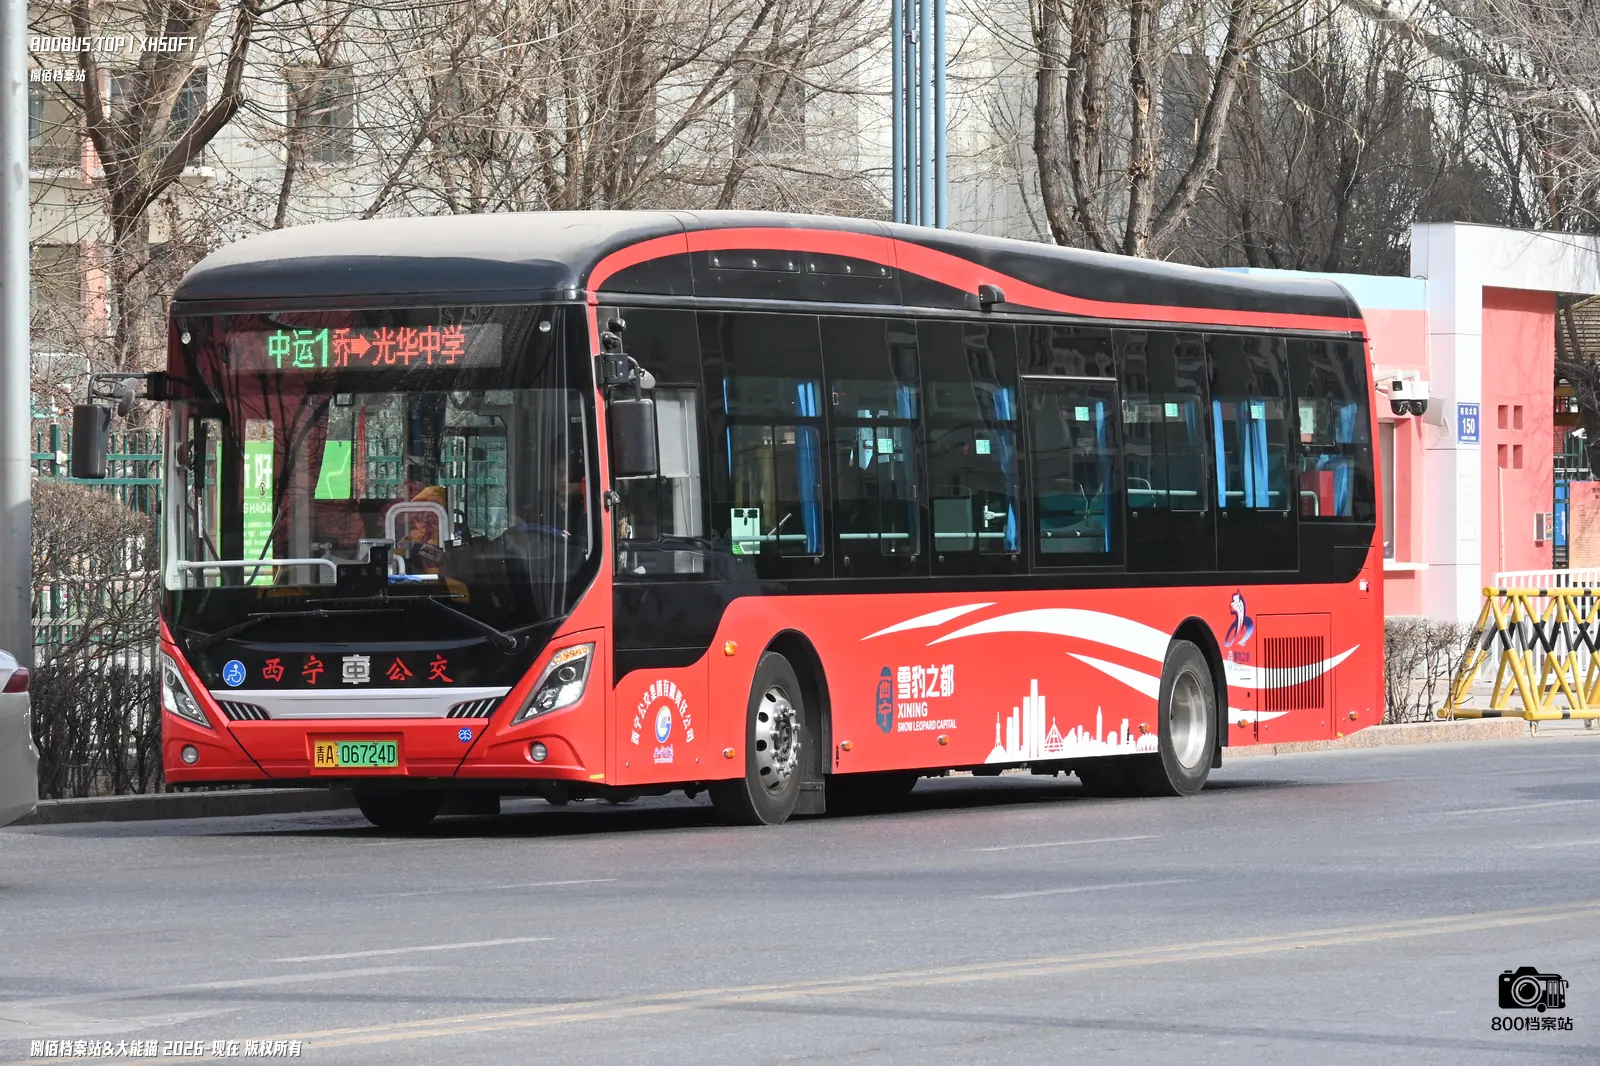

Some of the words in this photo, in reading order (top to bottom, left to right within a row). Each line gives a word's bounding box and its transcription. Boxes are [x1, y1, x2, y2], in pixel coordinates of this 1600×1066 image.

[268, 328, 328, 368] 中运1
[372, 324, 465, 366] 光华中学
[1462, 417, 1476, 434] 150
[897, 664, 954, 699] 雪豹之都
[897, 702, 928, 718] XINING
[897, 721, 913, 732] SNOW
[913, 720, 936, 731] LEOPARD
[936, 719, 957, 729] CAPITAL
